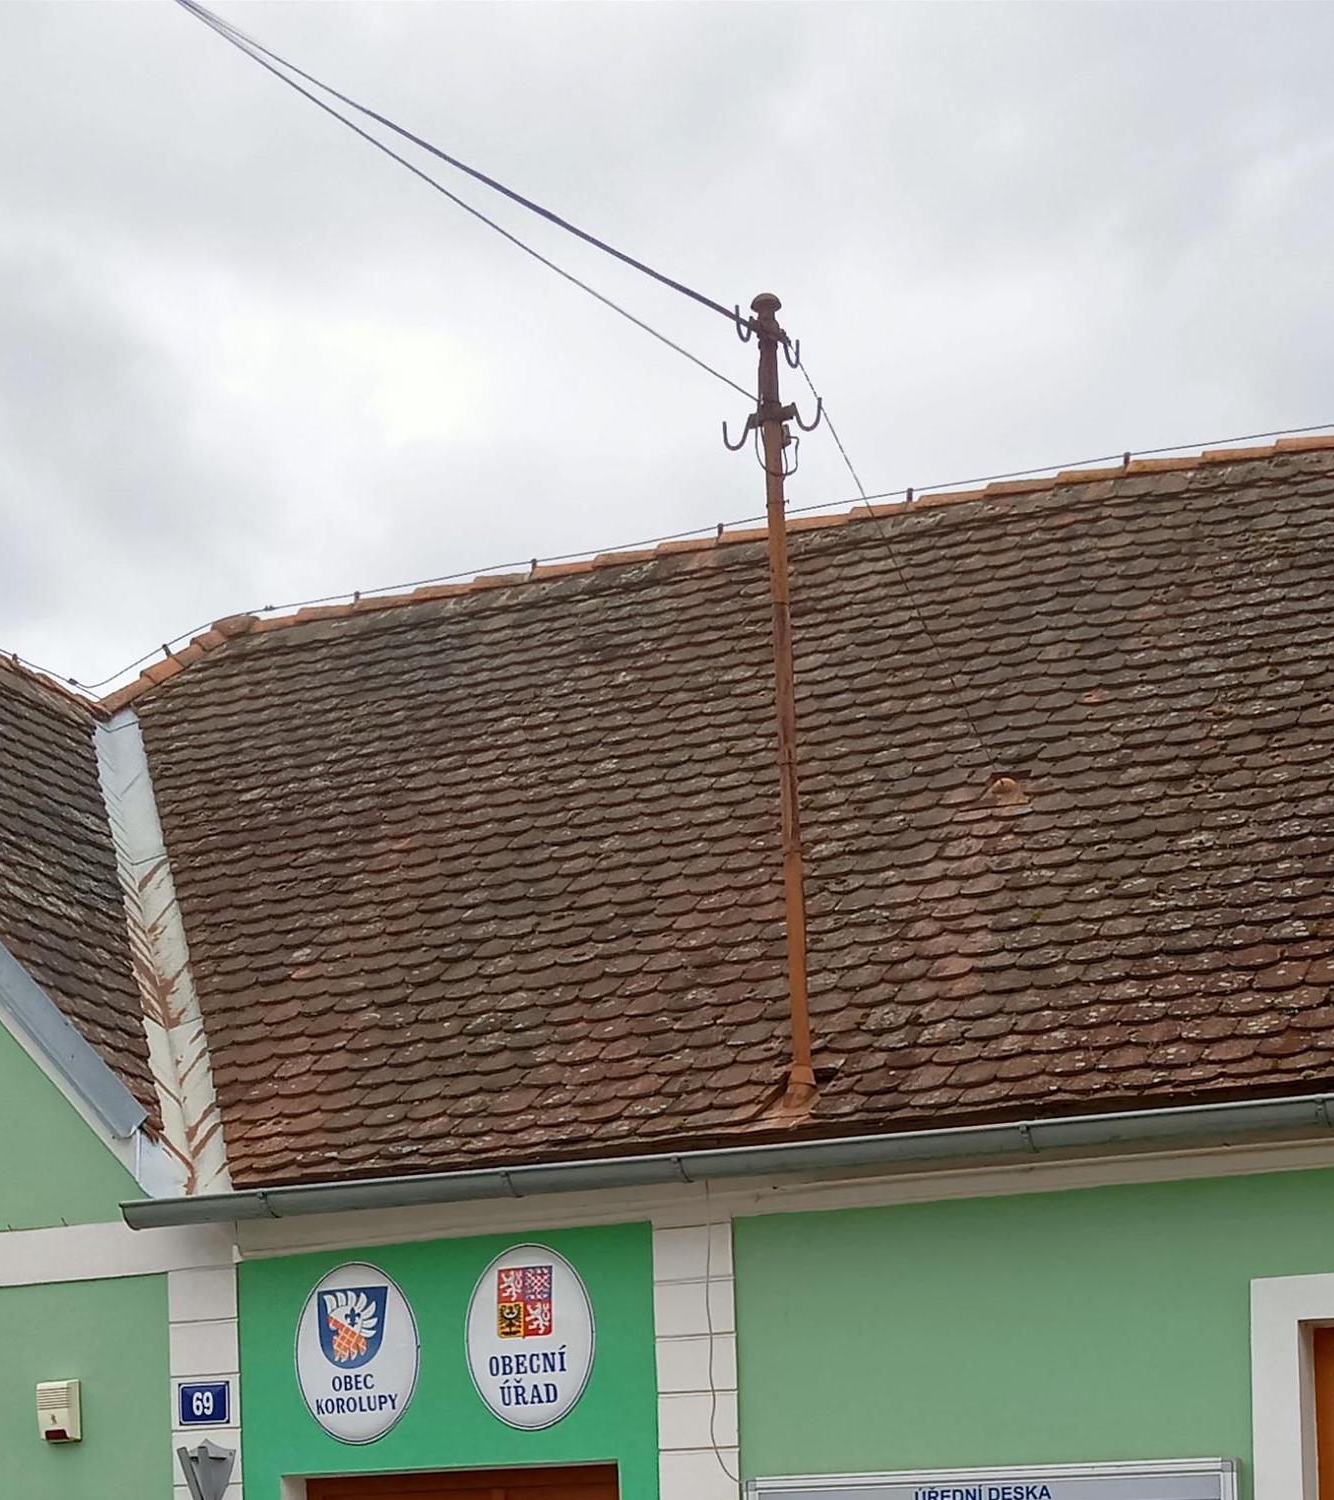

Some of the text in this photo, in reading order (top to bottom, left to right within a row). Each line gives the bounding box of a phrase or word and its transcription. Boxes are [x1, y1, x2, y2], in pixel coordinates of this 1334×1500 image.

[489, 1344, 567, 1377] OBECNÍ
[332, 1373, 375, 1392] OBEC
[499, 1377, 558, 1407] ÚŘAD
[192, 1391, 214, 1416] 69
[316, 1393, 398, 1416] KOROLUPY
